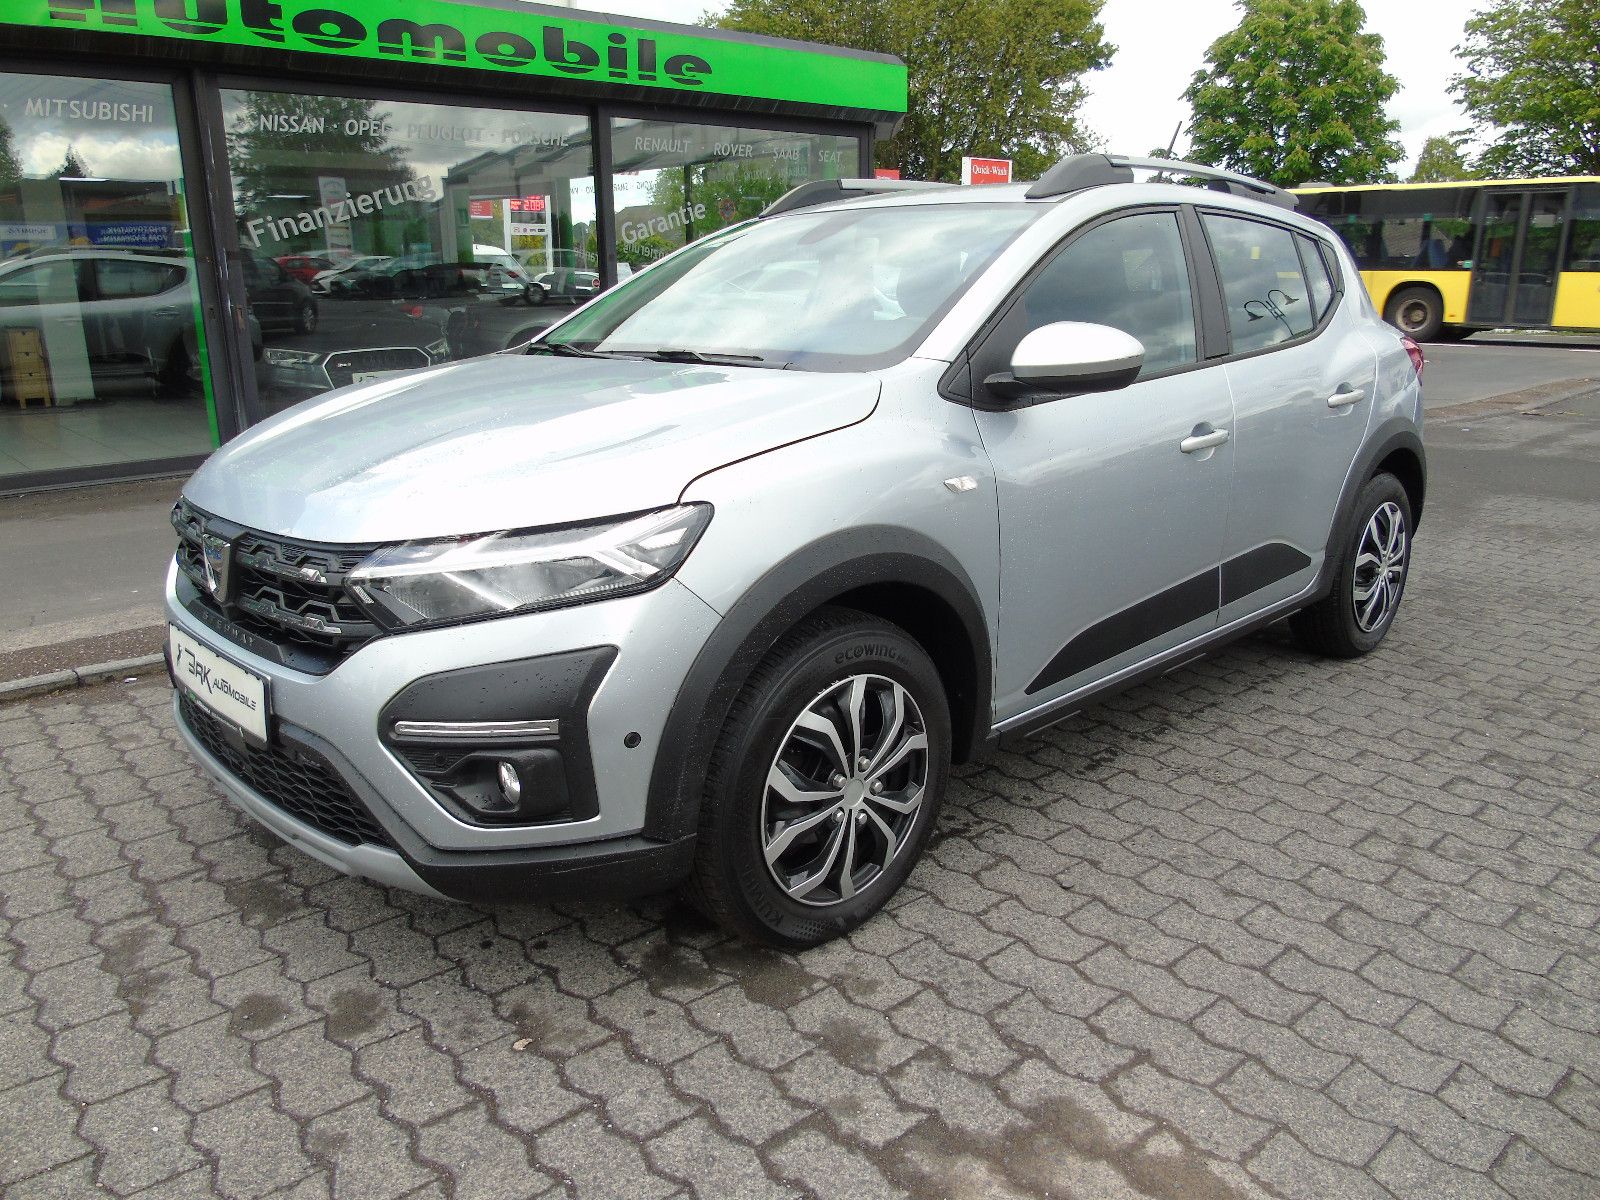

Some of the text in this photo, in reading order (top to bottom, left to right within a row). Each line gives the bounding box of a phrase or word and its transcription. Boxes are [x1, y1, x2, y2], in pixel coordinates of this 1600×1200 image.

[25, 98, 154, 123] MITSUBISHI
[259, 114, 569, 147] NISSAN OPEL PEUGEOT PORSCHE
[634, 136, 843, 163] RENAULT ROVER SAAB SEAT
[245, 174, 438, 249] Finanzierung
[621, 201, 706, 244] Garantie
[211, 677, 257, 711] AUTOMOBILE
